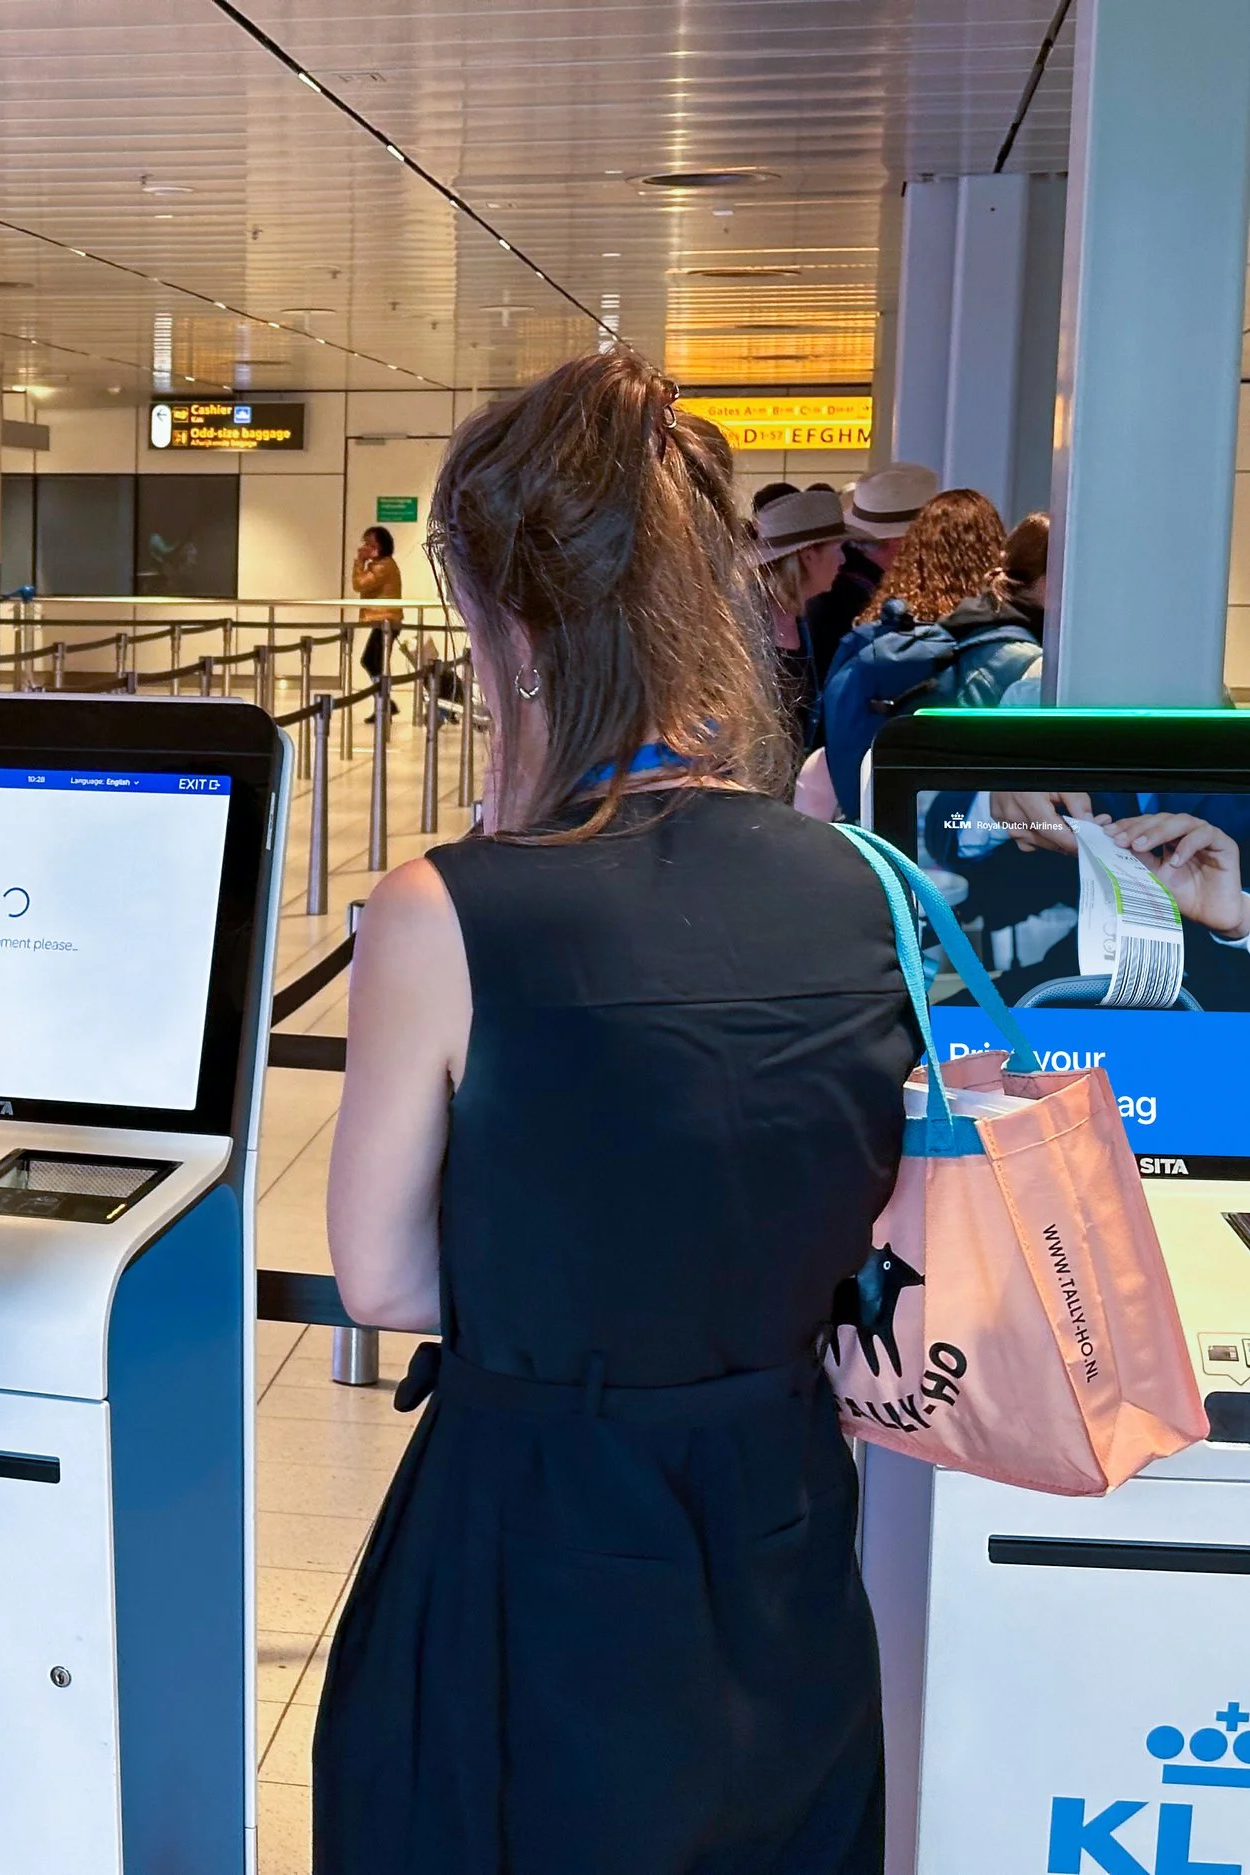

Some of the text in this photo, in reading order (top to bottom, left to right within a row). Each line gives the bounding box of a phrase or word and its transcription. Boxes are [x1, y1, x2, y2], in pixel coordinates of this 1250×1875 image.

[190, 404, 232, 415] Cashier
[708, 406, 740, 416] Gates
[190, 426, 291, 441] Odd-size baggage
[106, 777, 131, 787] English
[178, 778, 207, 791] EXIT
[943, 820, 1063, 832] KLM Royal Dutch Airlines
[1117, 1095, 1157, 1125] ag
[1139, 1157, 1189, 1175] SITA
[1043, 1223, 1099, 1384] WWW.TALLY-HO.NL
[1047, 1796, 1243, 1875] KL
